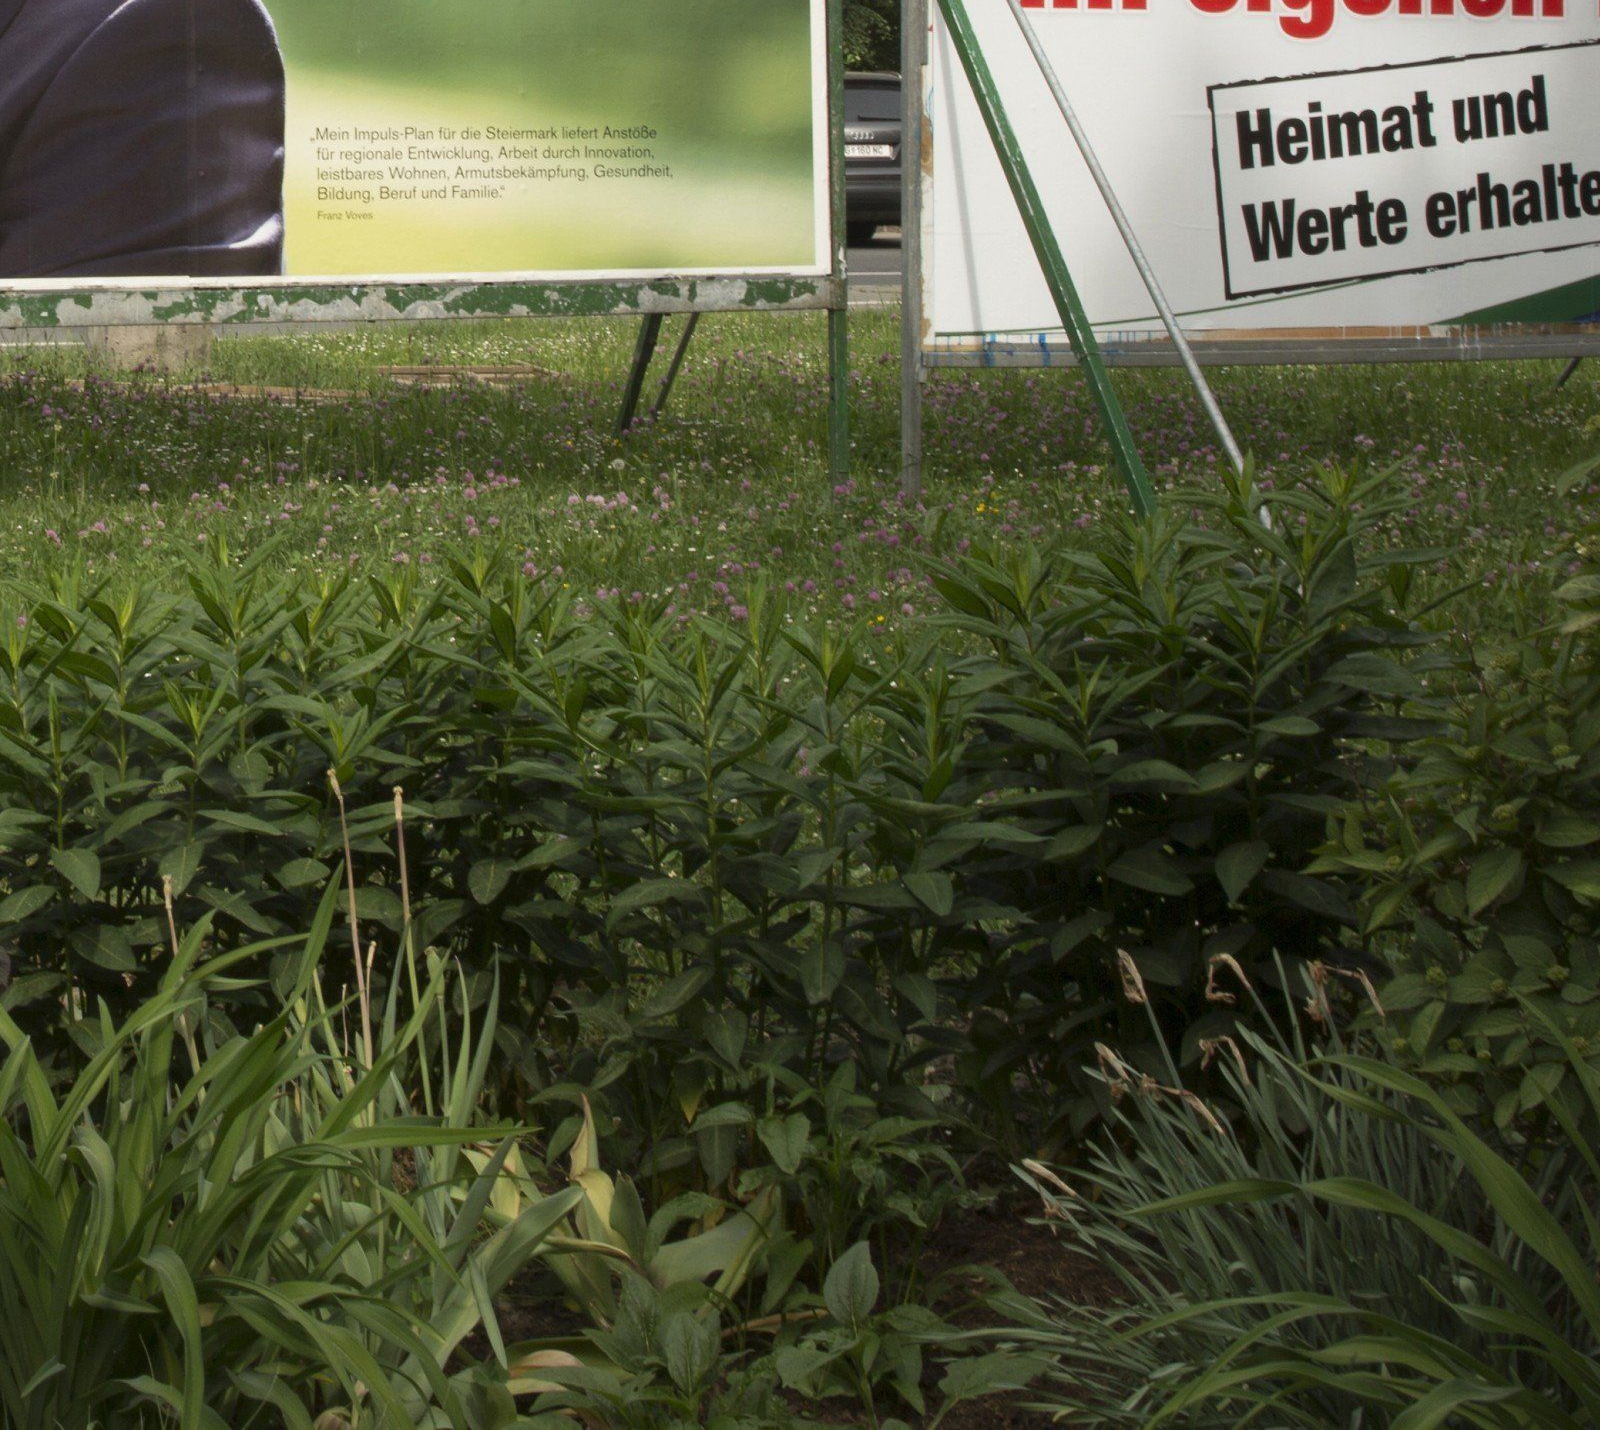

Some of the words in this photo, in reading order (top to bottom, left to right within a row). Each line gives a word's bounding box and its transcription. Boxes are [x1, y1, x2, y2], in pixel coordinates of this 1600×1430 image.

[1235, 90, 1437, 170] Heimat
[1452, 74, 1549, 143] und
[354, 127, 434, 143] Impuls-Plan
[438, 126, 457, 140] für
[461, 126, 481, 140] die
[486, 126, 558, 140] Steiermark
[562, 126, 598, 139] liefert
[602, 125, 657, 140] Anstöße
[316, 147, 335, 160] für
[339, 147, 403, 164] regionale
[408, 146, 493, 162] Entwicklung,
[498, 145, 538, 159] Arbeit
[542, 146, 580, 159] durch
[584, 146, 655, 160] Innovation,
[317, 167, 384, 181] leistbares
[389, 167, 450, 181] Wohnen,
[454, 165, 589, 182] Armutsbekämpfung,
[593, 164, 674, 179] Gesundheit,
[317, 186, 375, 203] Bildung,
[379, 185, 417, 200] Beruf
[421, 185, 447, 200] und
[317, 210, 342, 220] Franz
[345, 210, 374, 220] Voves
[1241, 190, 1408, 263] Werte
